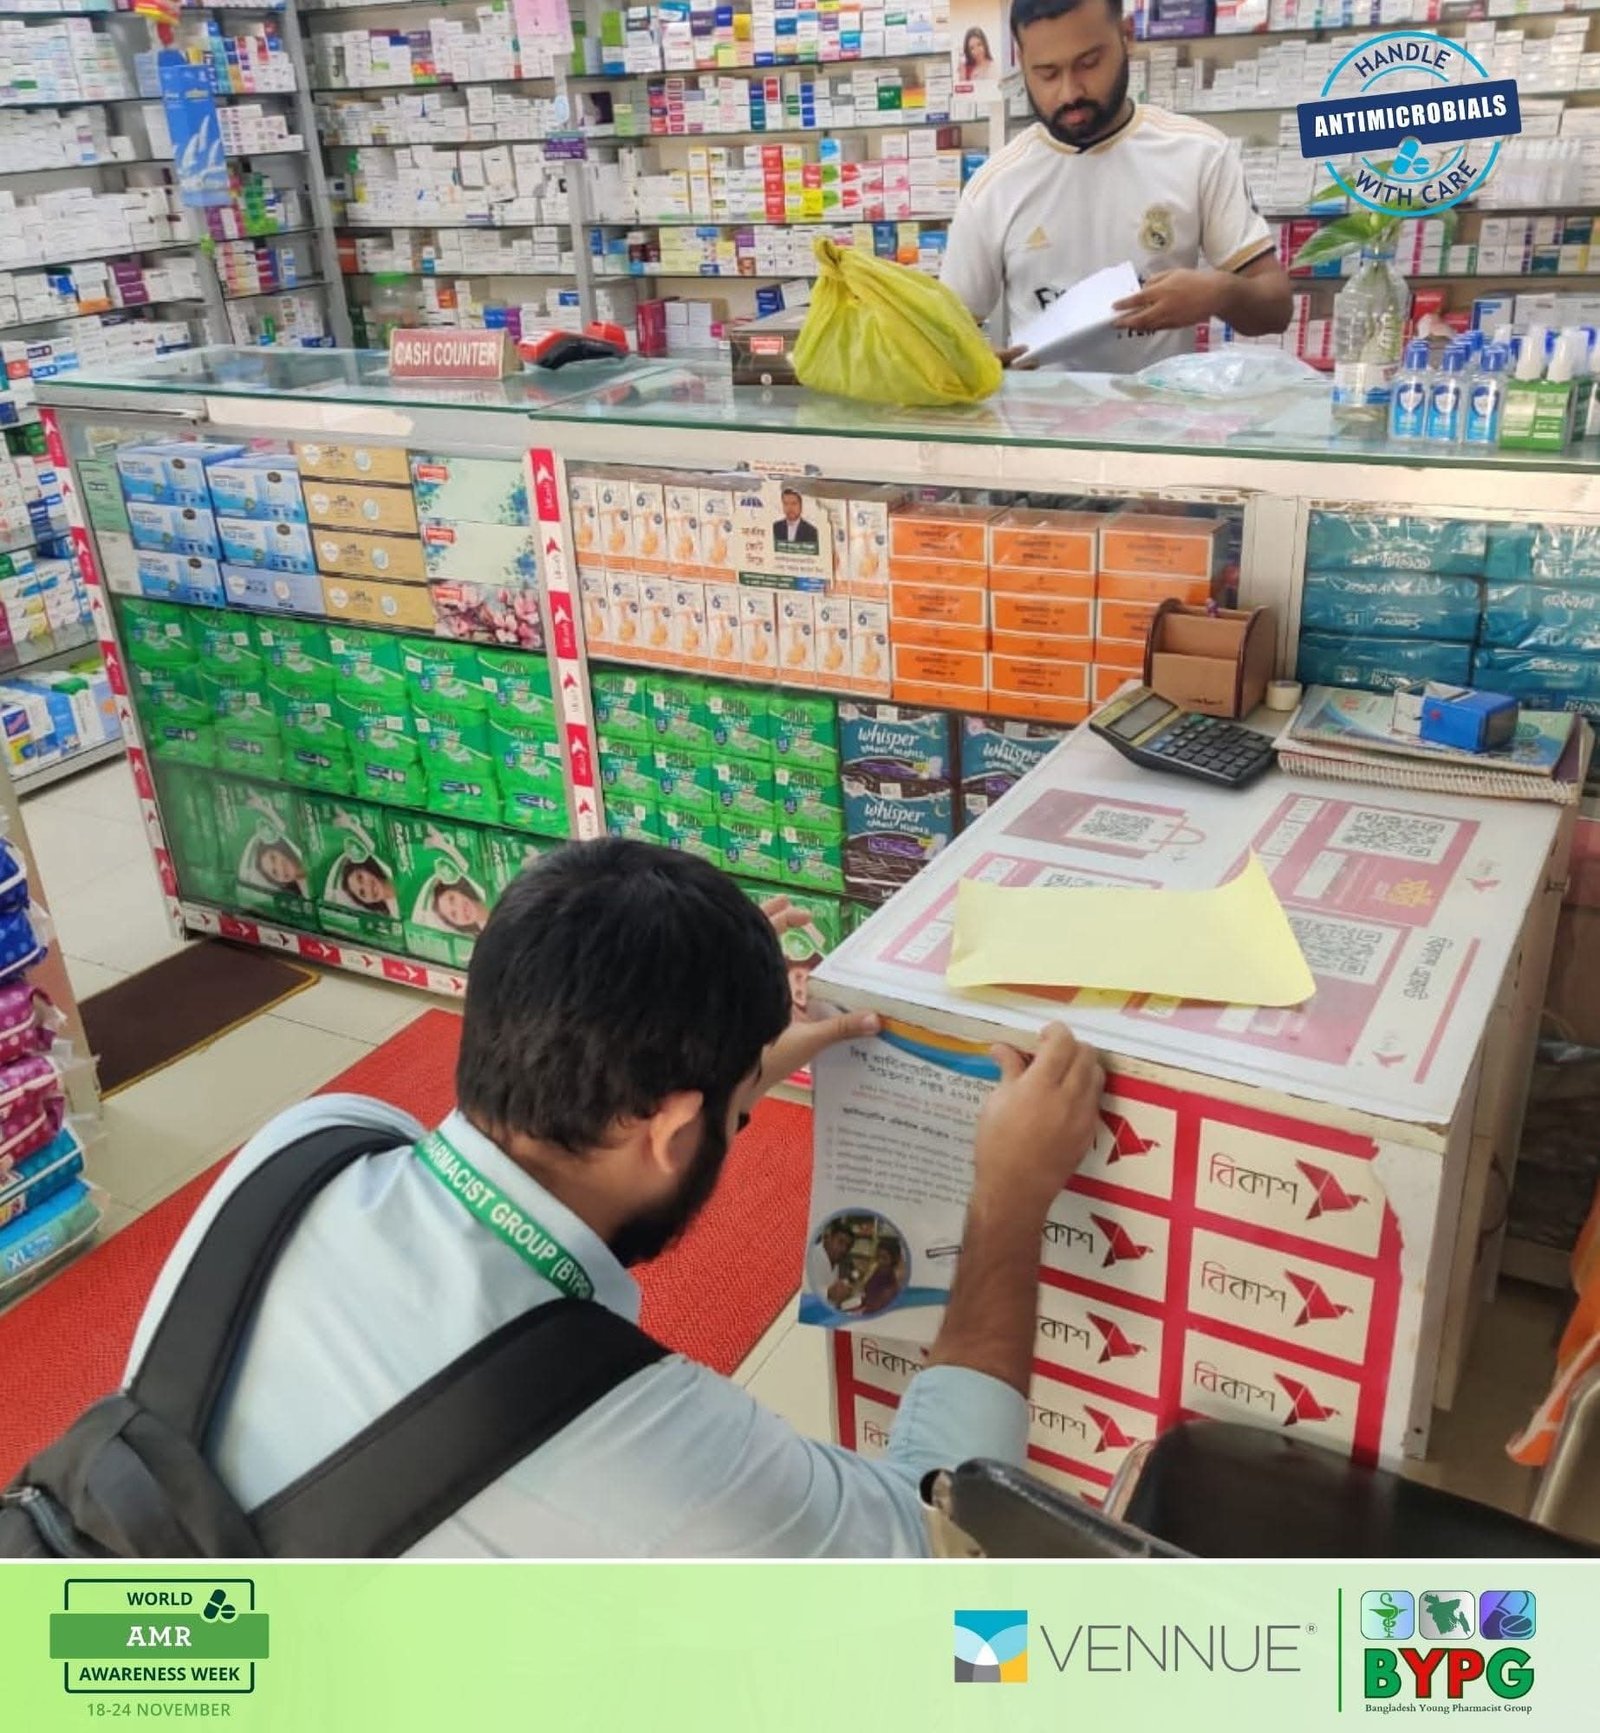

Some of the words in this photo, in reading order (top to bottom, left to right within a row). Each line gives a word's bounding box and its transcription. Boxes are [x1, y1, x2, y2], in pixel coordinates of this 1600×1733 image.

[394, 342, 431, 366] CASH
[434, 342, 497, 366] COUNTER
[858, 723, 920, 749] whisper
[982, 738, 1047, 765] whispe
[864, 800, 926, 825] whisper
[1210, 1152, 1299, 1205] বিকাশ
[490, 1203, 557, 1260] GROUP
[1043, 1220, 1094, 1254] কাশ
[1201, 1261, 1287, 1313] বিকাশ
[1038, 1315, 1091, 1350] কাশ
[1194, 1360, 1276, 1412] বিকাশ
